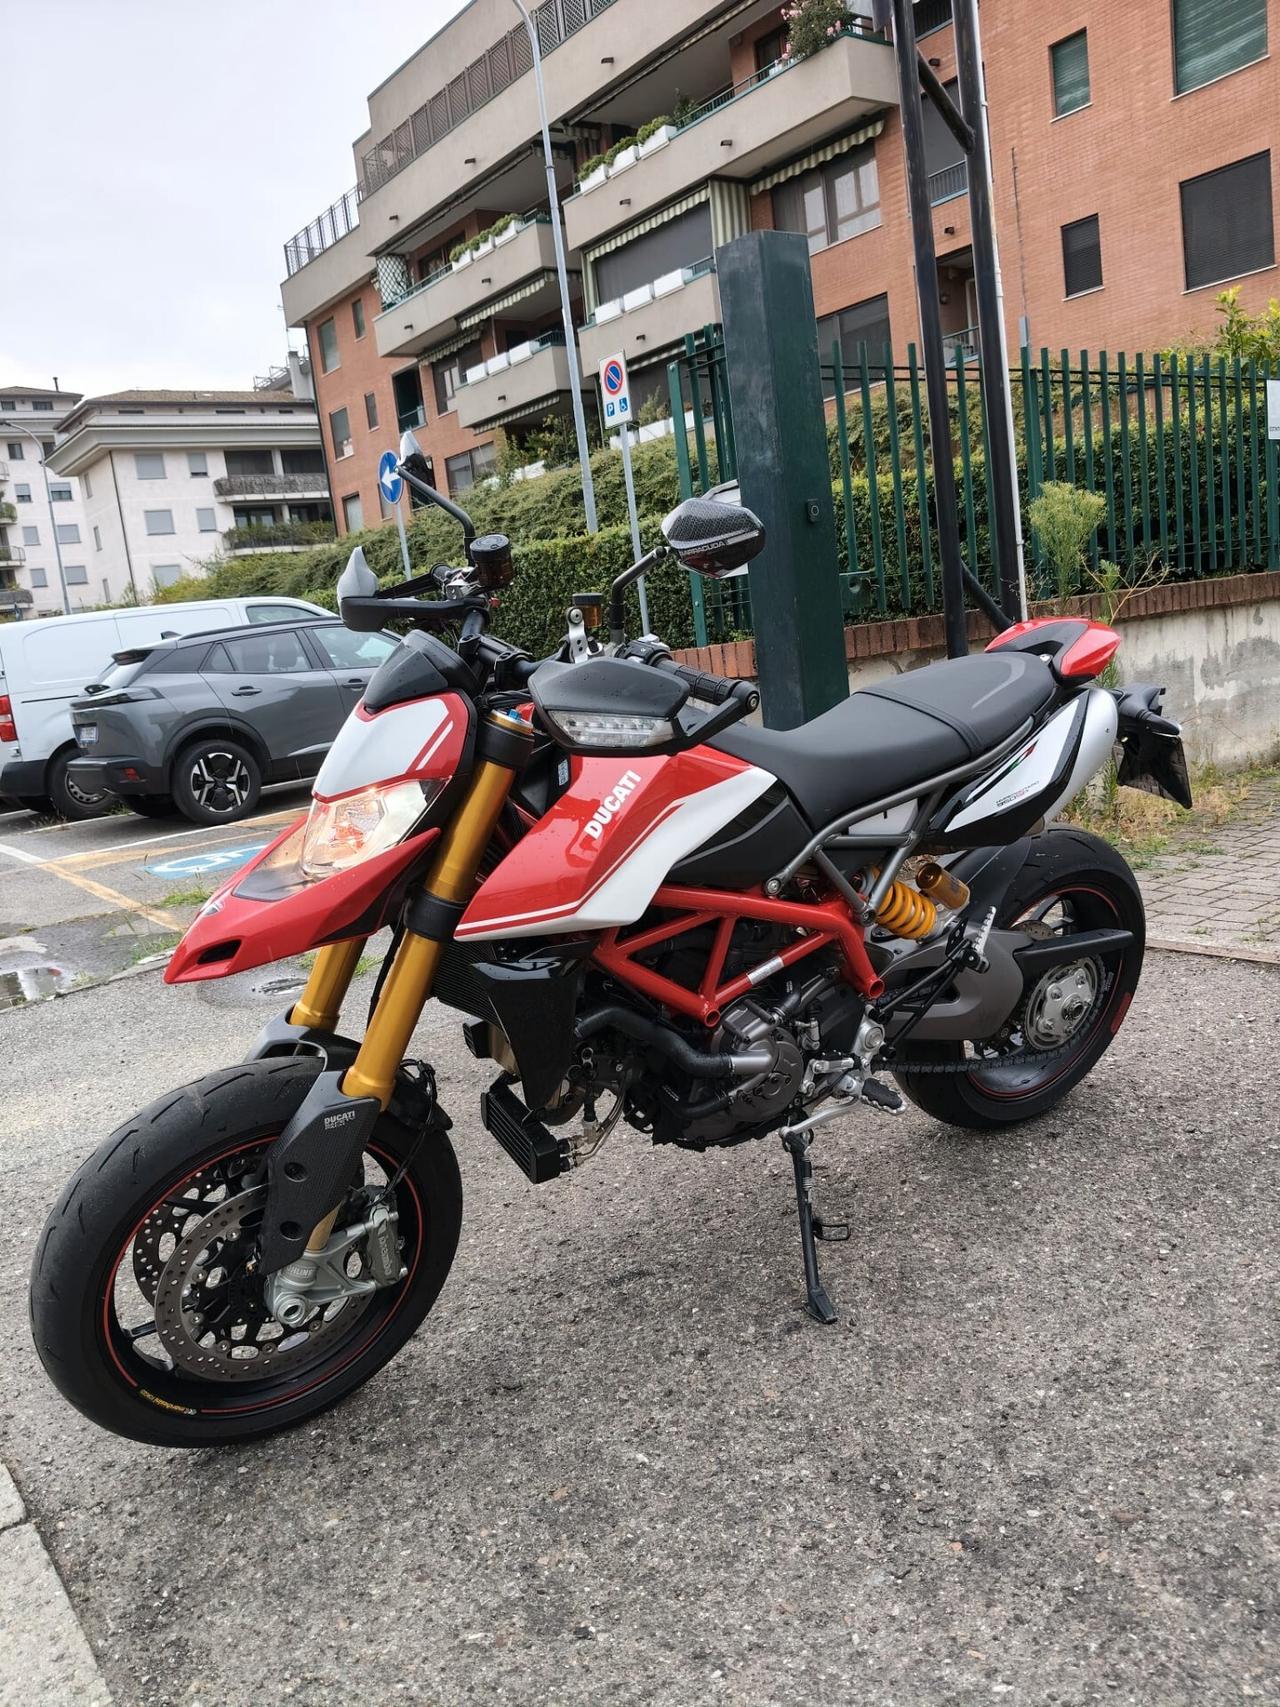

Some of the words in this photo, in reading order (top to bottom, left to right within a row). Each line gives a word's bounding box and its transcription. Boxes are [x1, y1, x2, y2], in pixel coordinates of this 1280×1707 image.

[607, 404, 614, 416] P
[583, 769, 642, 840] DUCATI
[324, 1110, 355, 1124] DUCATI
